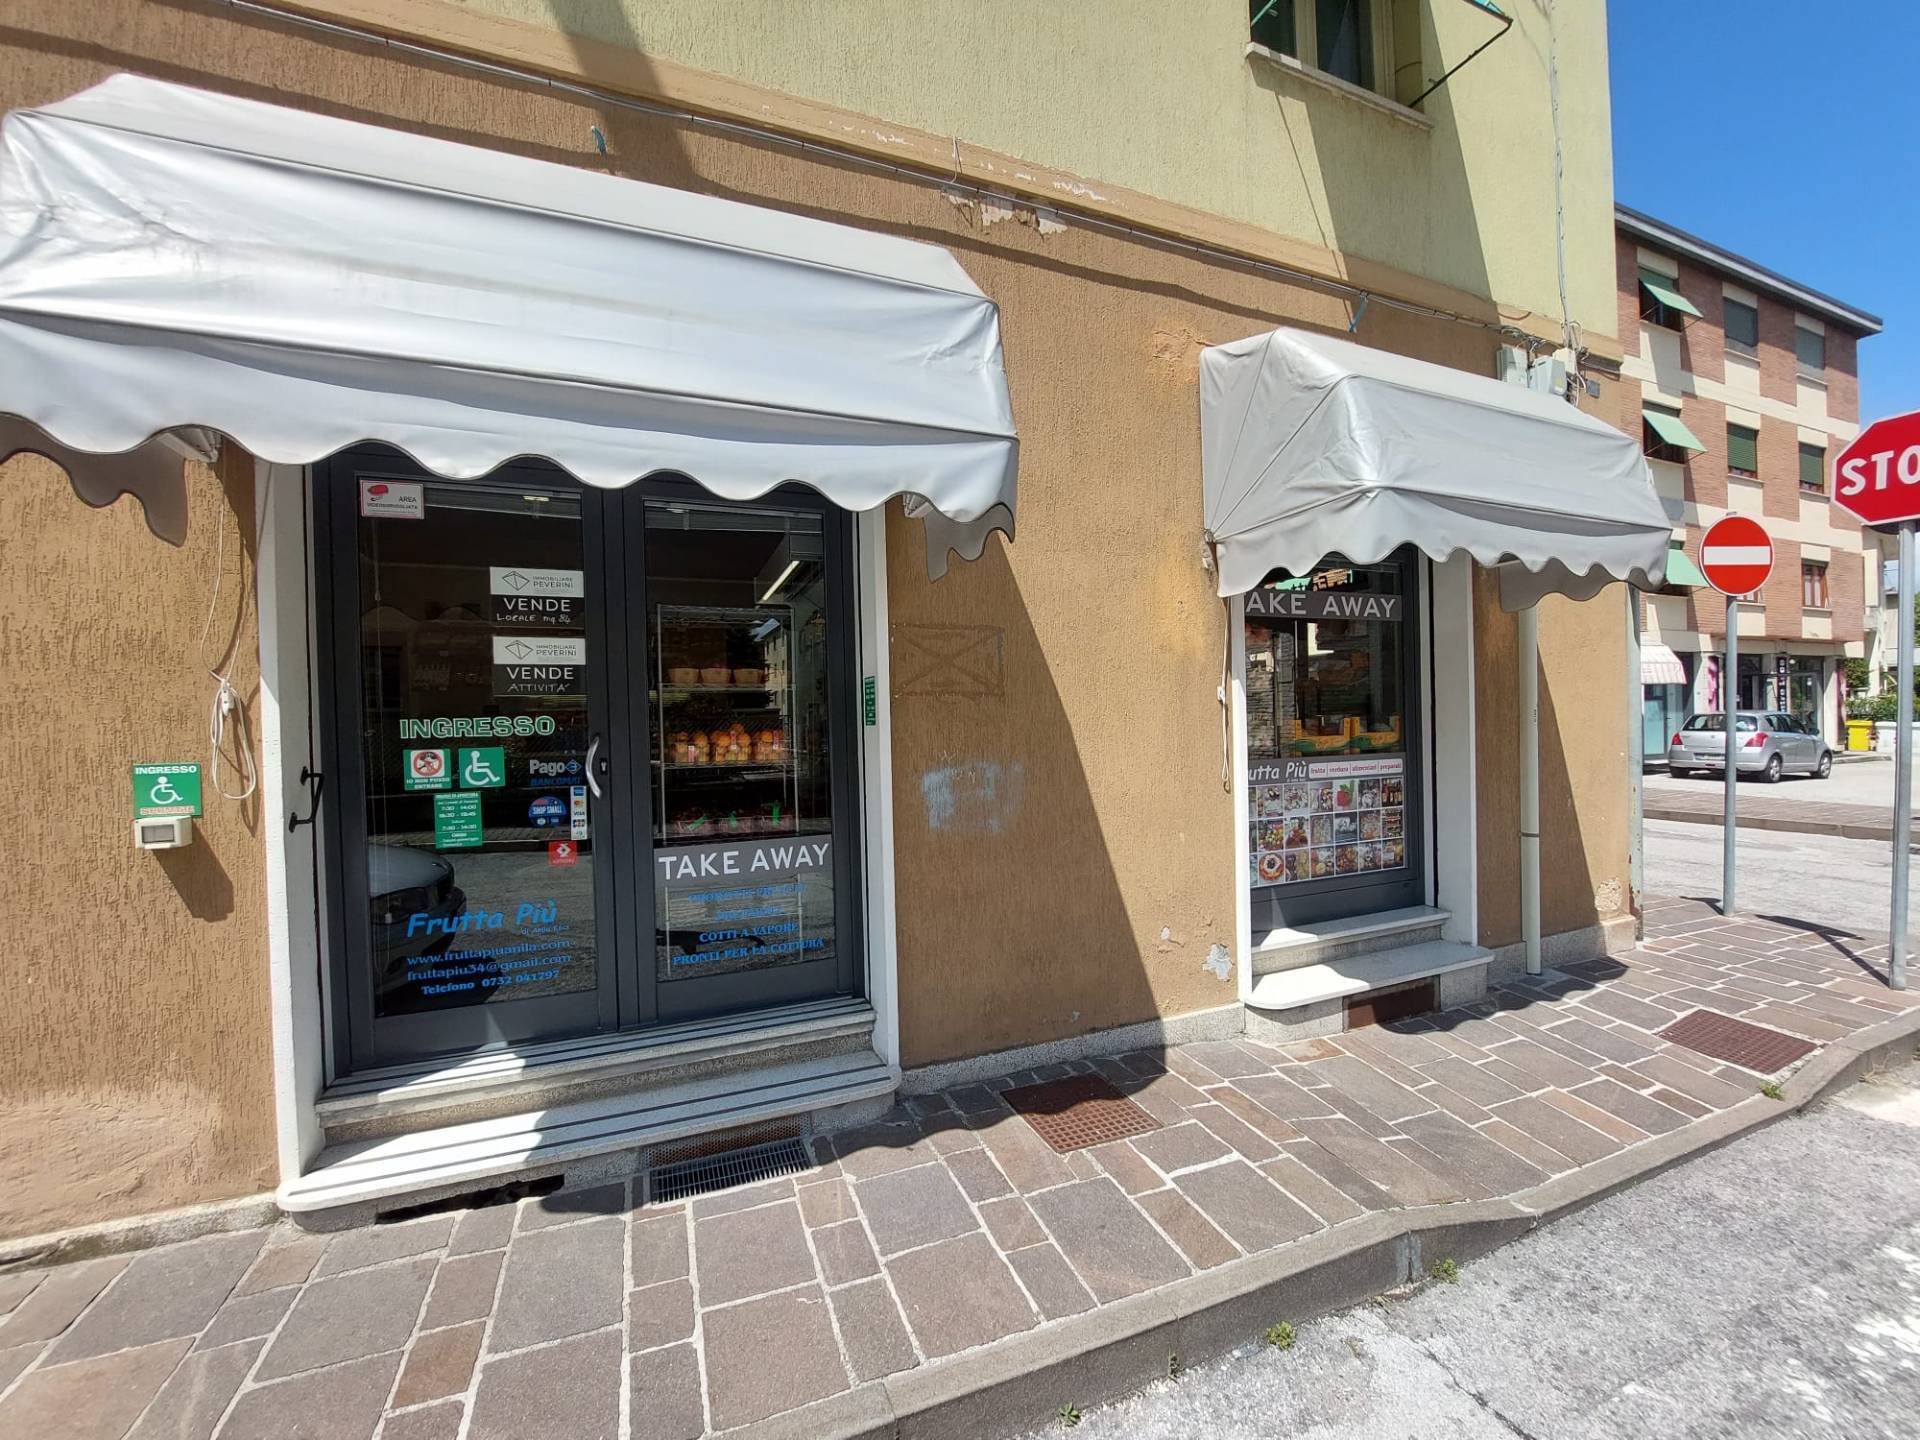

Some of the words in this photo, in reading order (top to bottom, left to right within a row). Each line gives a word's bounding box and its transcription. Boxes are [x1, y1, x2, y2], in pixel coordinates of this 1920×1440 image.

[504, 597, 571, 612] VENDE
[1244, 591, 1307, 615] AKE
[1322, 596, 1396, 618] AWAY
[496, 613, 536, 622] LOCALE
[506, 667, 574, 680] VENDE
[400, 716, 556, 739] INGRESSO
[135, 765, 197, 774] INGRESSO
[530, 760, 565, 776] Pago
[1285, 761, 1308, 778] Più
[658, 850, 740, 880] TAKE
[750, 843, 829, 872] AWAY
[407, 912, 504, 937] Frutta
[515, 901, 557, 925] Più
[699, 931, 737, 942] COTTI
[752, 922, 798, 935] VAPORE
[673, 952, 720, 966] PRONTI
[724, 946, 748, 958] PER
[771, 938, 825, 953] COTTURA
[421, 982, 475, 995] Telefono
[481, 975, 512, 988] 0732
